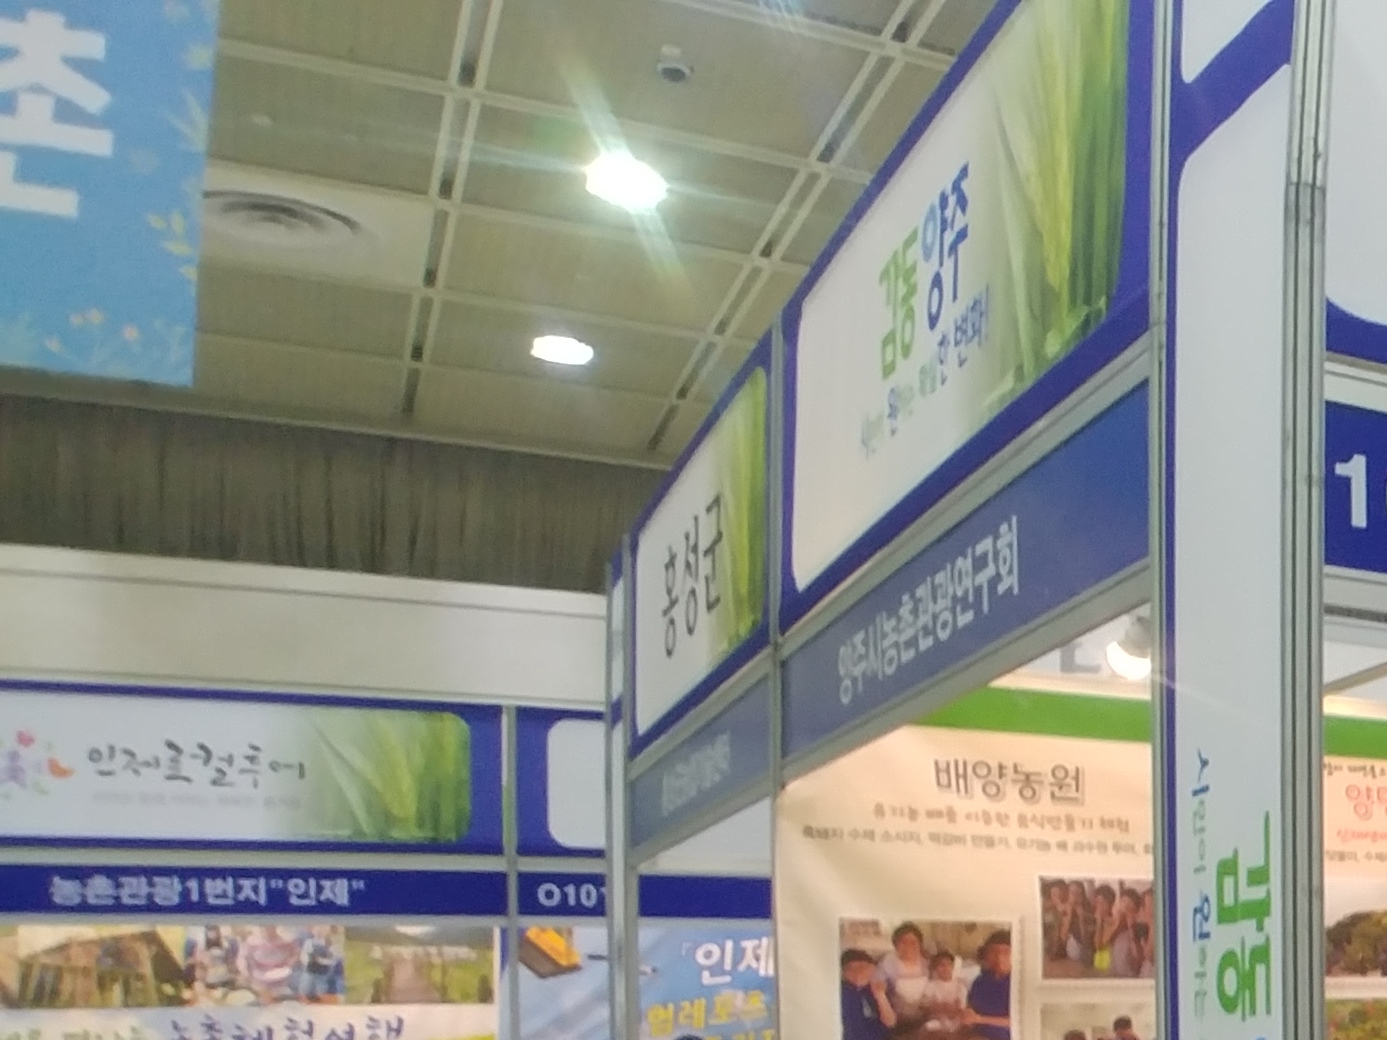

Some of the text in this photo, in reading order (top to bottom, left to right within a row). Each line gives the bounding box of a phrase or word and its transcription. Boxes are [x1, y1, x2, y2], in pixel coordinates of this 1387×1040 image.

[921, 160, 969, 332] 양주
[662, 493, 724, 661] 홍성군
[837, 514, 1020, 705] 양주시농촌관광연구회
[933, 758, 1084, 804] 배양농원
[536, 881, 606, 909] O10
[1216, 809, 1272, 1023] 감동
